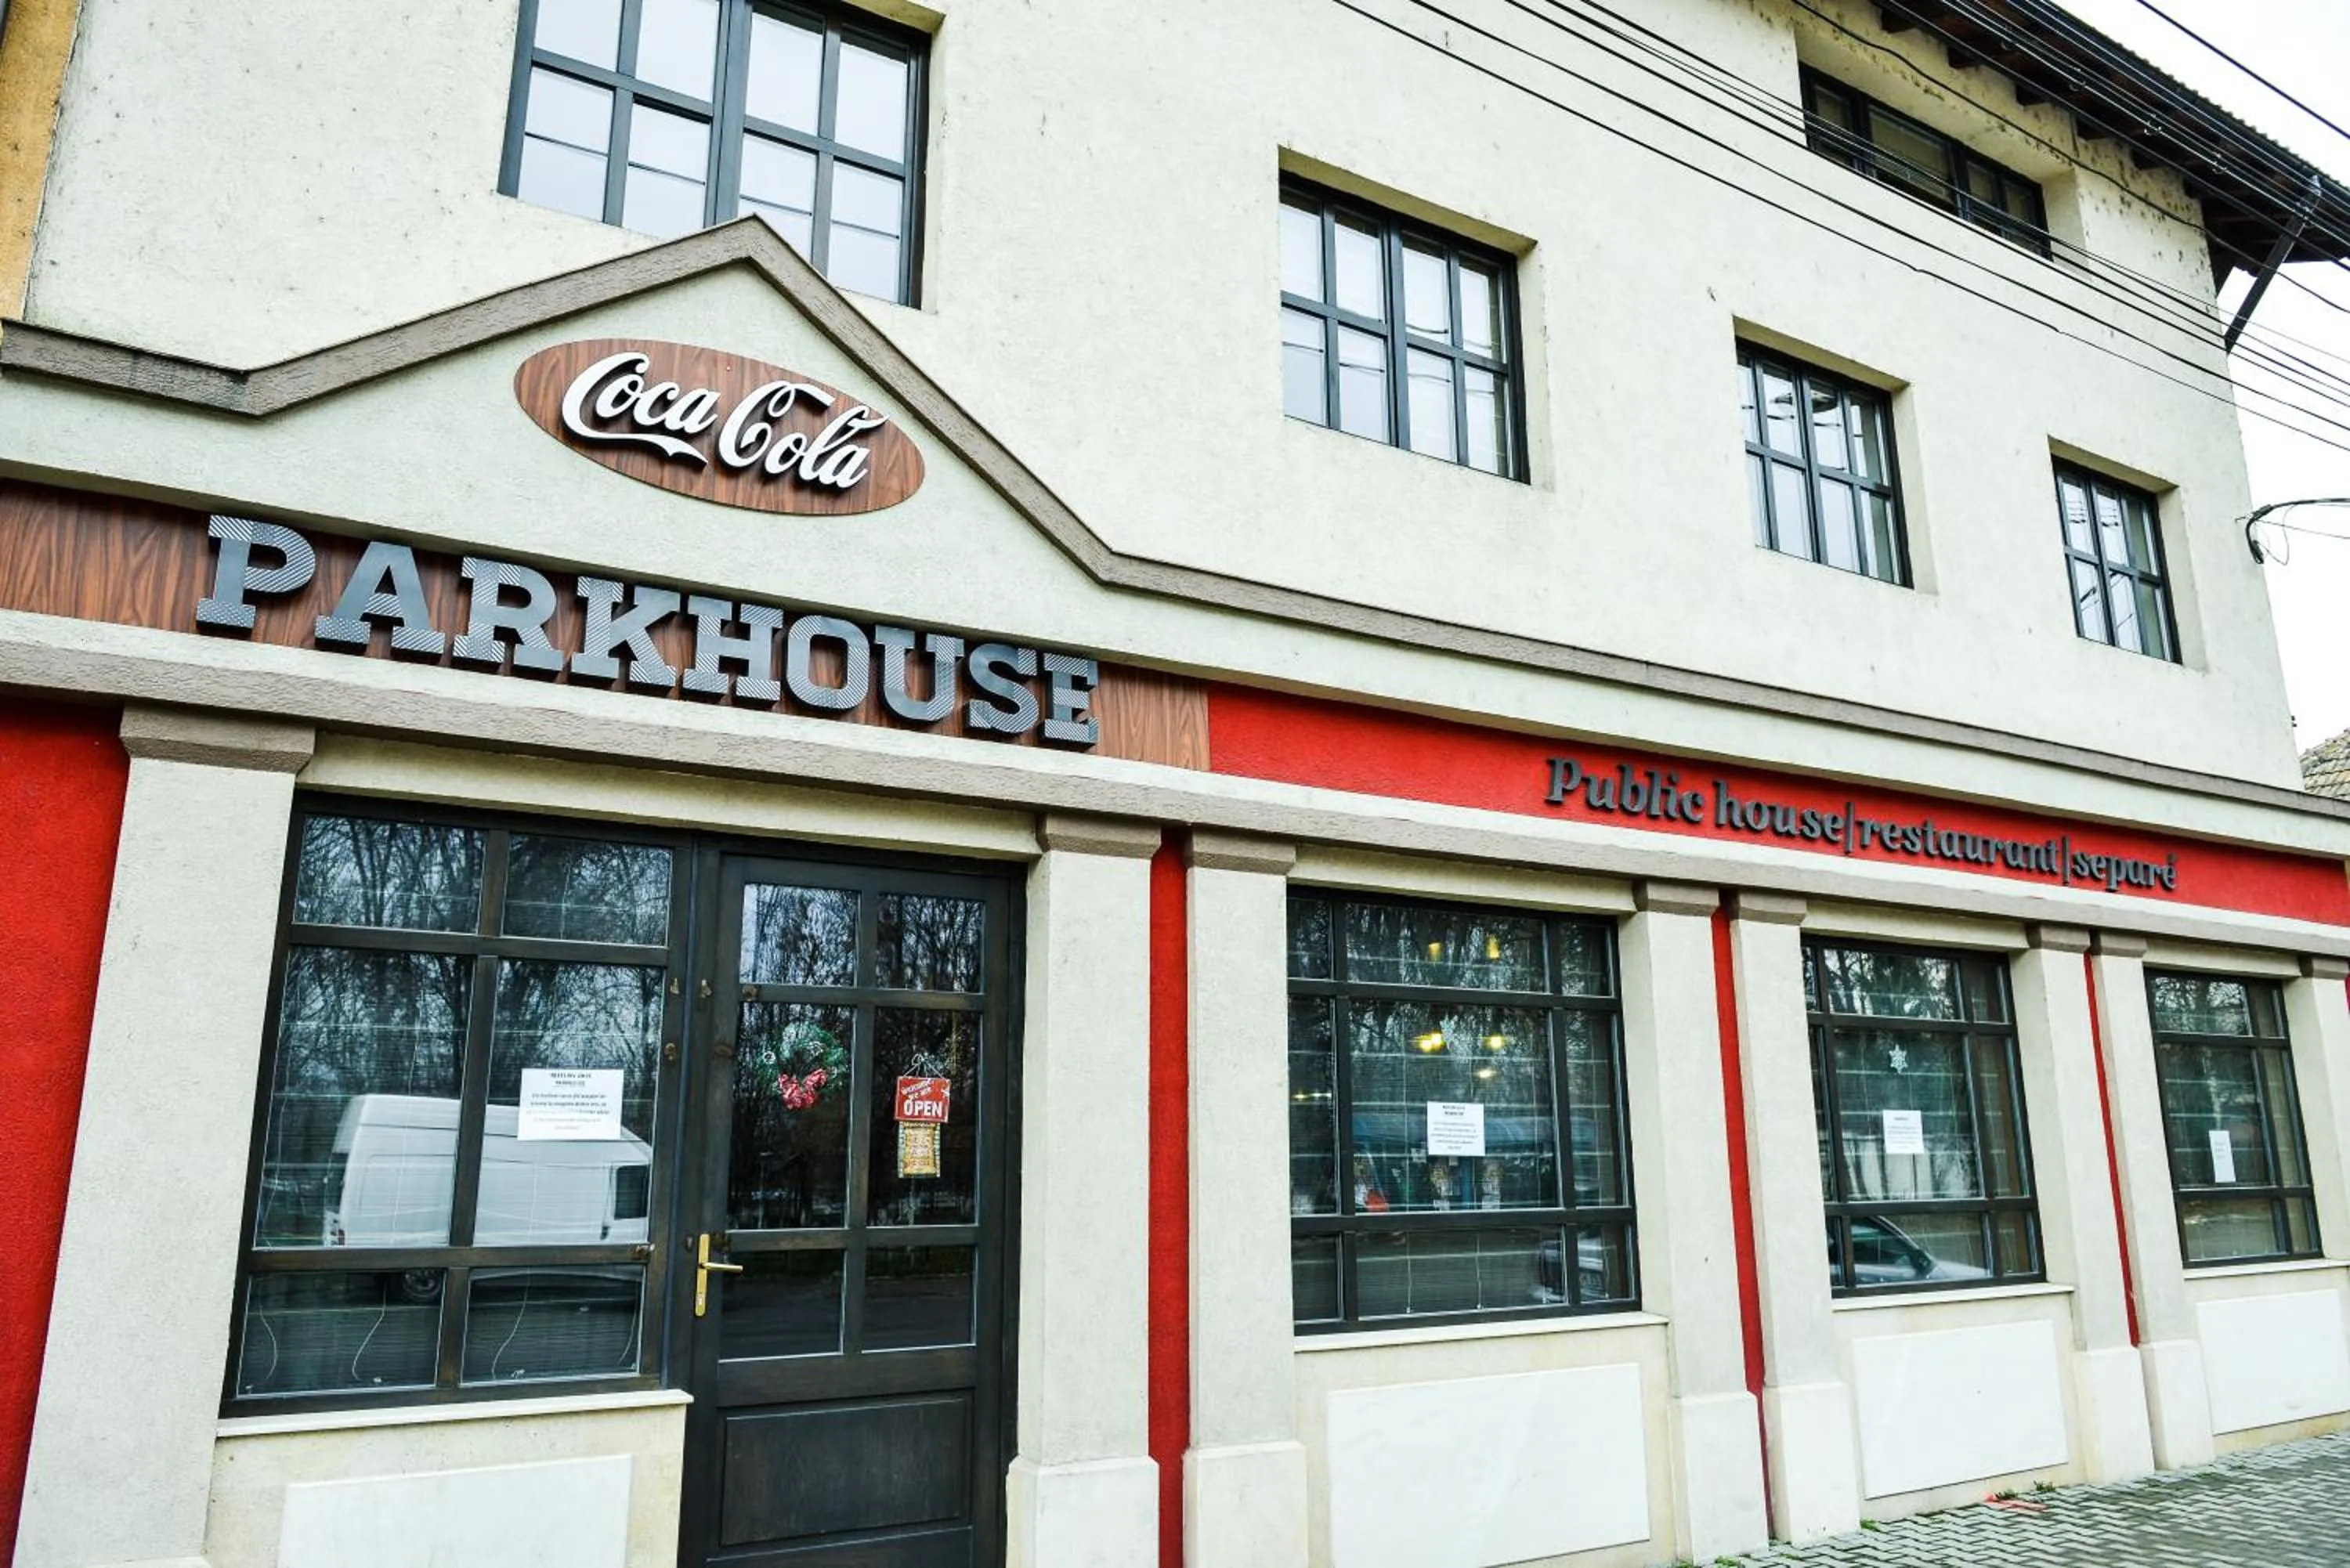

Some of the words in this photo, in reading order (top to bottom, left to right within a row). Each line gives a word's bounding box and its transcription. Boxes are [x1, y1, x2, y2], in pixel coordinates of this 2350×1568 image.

[561, 352, 721, 464] Coca
[718, 380, 890, 489] Cola
[197, 515, 1101, 744] PARKHOUSE
[1545, 757, 1705, 823] Public
[903, 1099, 943, 1118] OPEN
